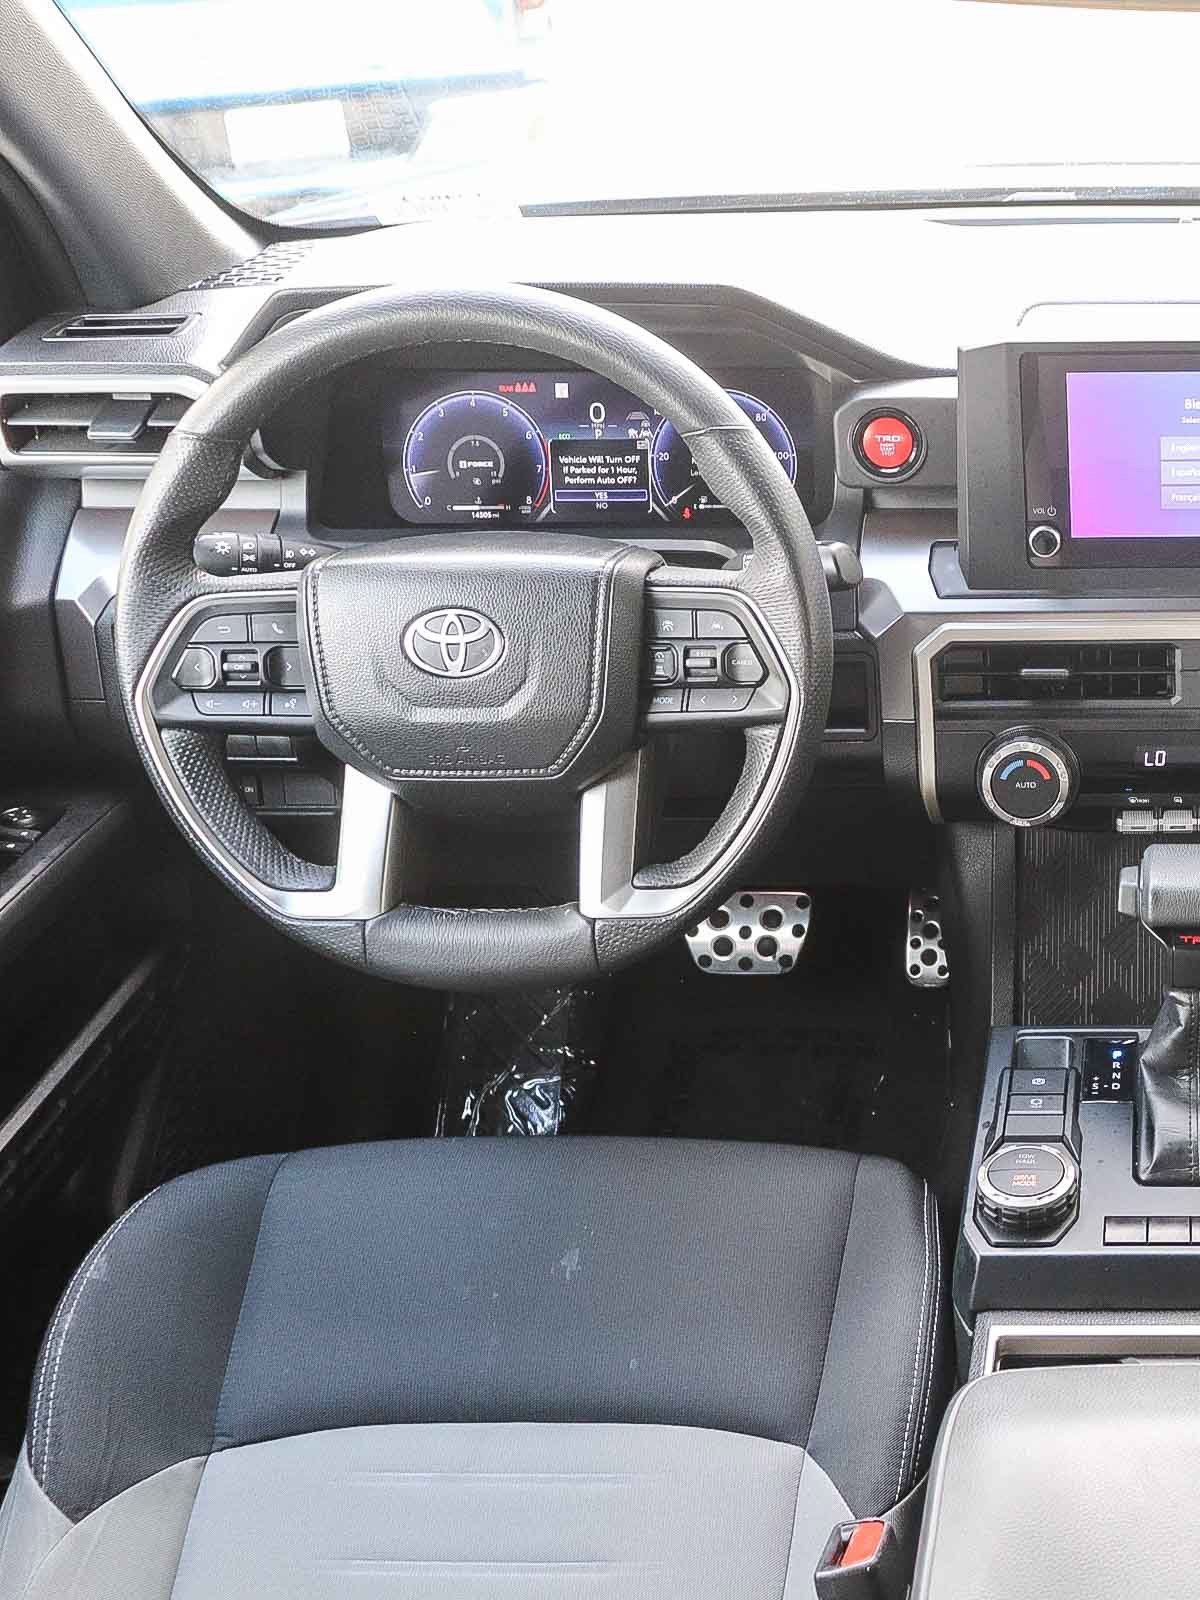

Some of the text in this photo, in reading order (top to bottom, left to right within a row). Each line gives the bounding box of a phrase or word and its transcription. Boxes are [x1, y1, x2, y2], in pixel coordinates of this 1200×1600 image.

[438, 407, 445, 417] 3
[502, 407, 509, 417] 5
[589, 402, 606, 423] 0
[417, 432, 424, 441] 2
[525, 431, 532, 440] 6
[559, 455, 641, 464] Vehicle Will Turn OFF
[658, 453, 670, 461] 20
[563, 465, 569, 474] If
[570, 465, 597, 474] Parked
[598, 465, 609, 474] for
[616, 465, 638, 475] Hour,
[565, 476, 637, 485] Perform Auto OFF?
[594, 491, 608, 499] YES
[423, 496, 431, 506] 0
[526, 496, 532, 505] 8
[1015, 781, 1037, 789] AUTO
[1112, 1050, 1122, 1060] P
[1112, 1072, 1121, 1080] N
